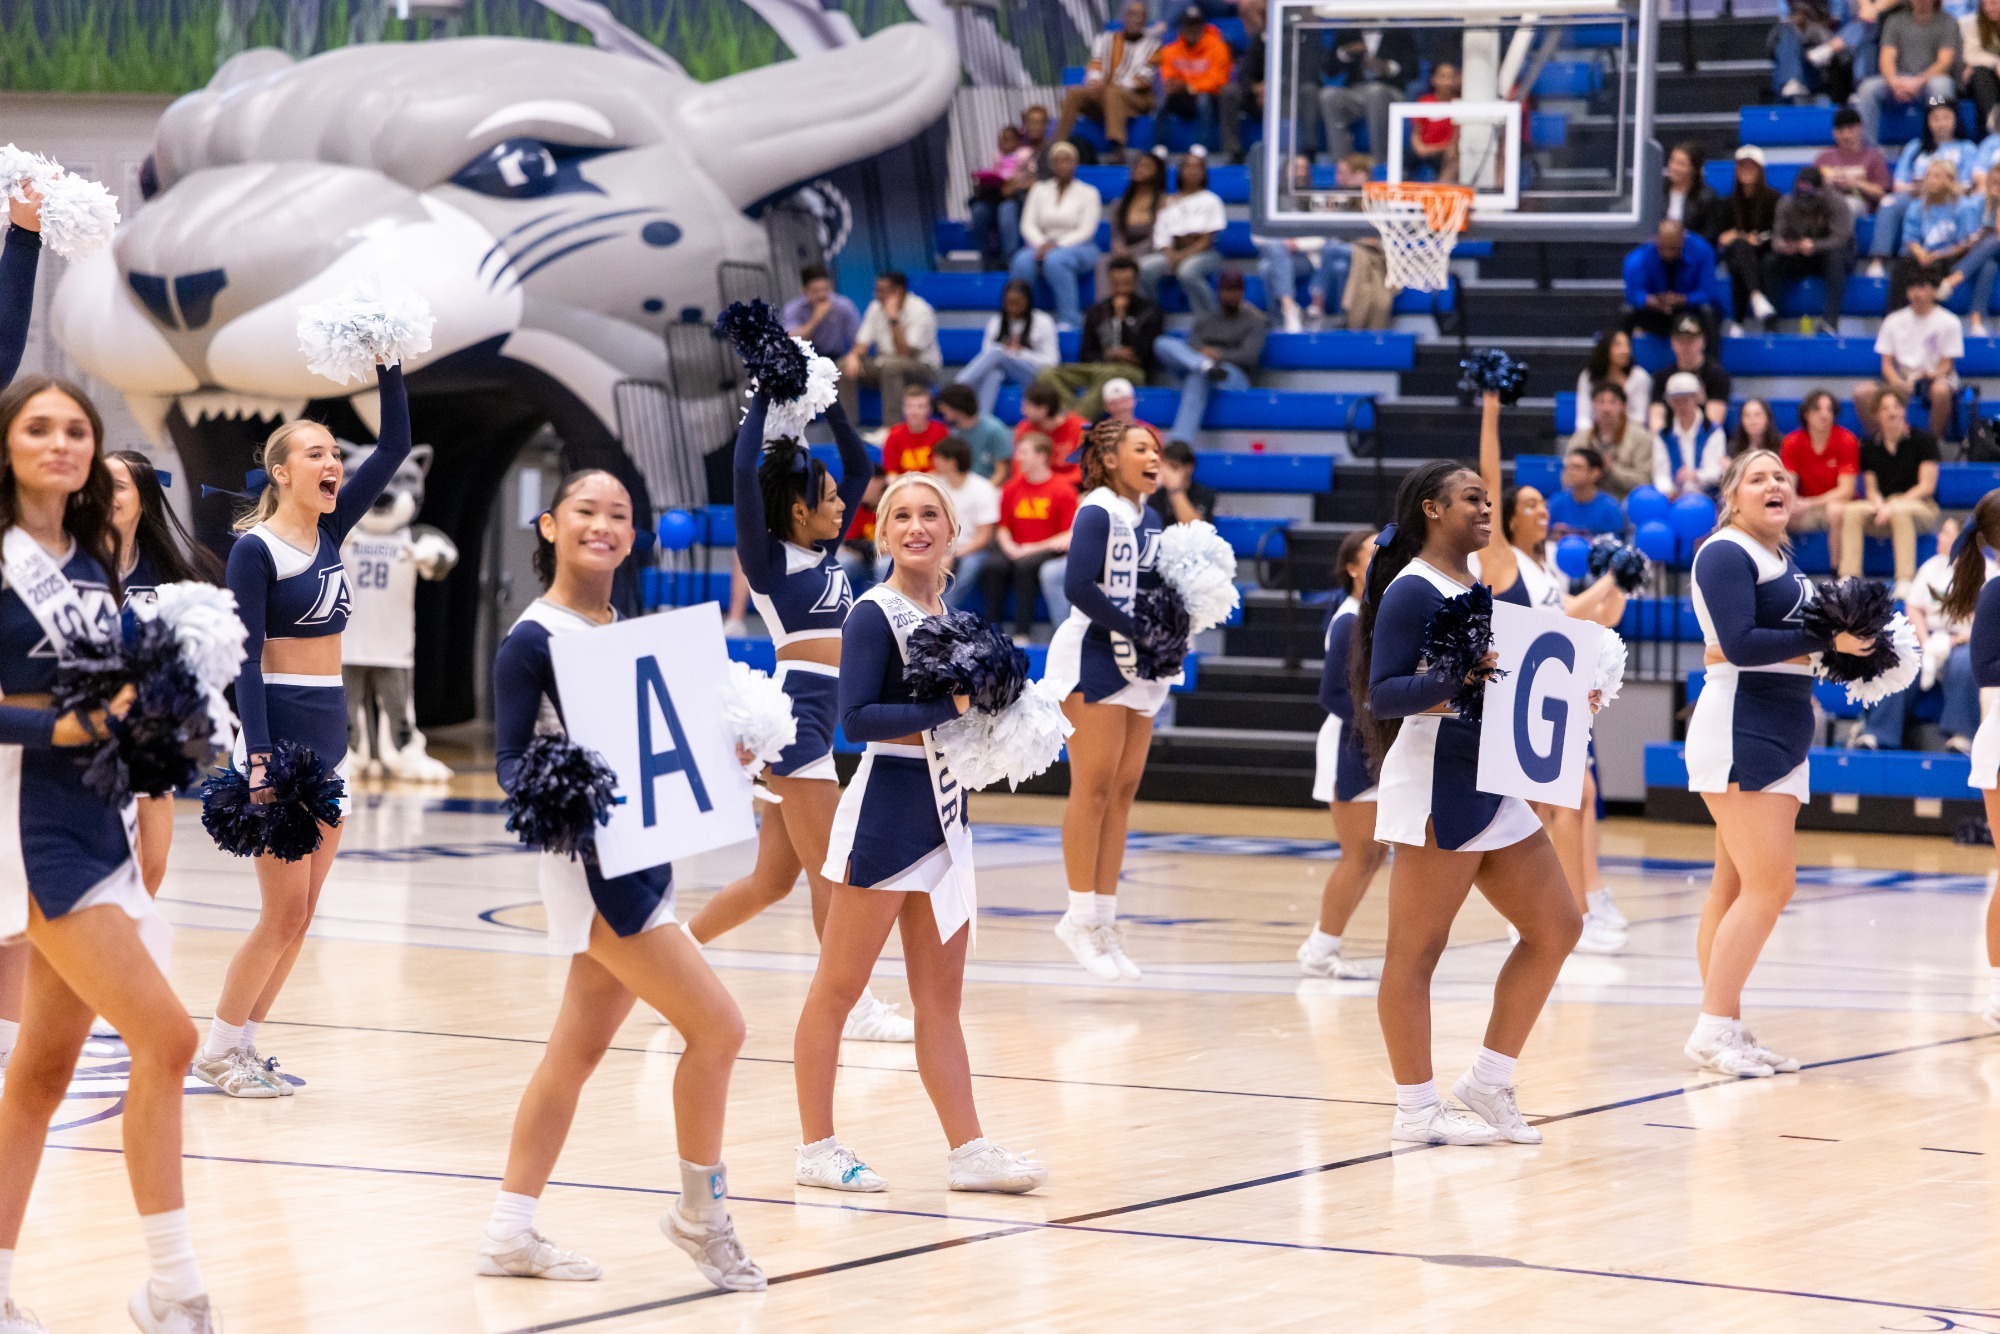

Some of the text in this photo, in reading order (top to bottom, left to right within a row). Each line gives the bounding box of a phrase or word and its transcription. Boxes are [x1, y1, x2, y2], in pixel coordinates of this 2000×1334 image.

[27, 573, 65, 605] 2025
[357, 560, 389, 589] 28
[293, 562, 354, 625] A
[881, 596, 903, 606] CLASS
[892, 610, 920, 629] 2025
[1513, 631, 1576, 783] G
[636, 654, 714, 828] A
